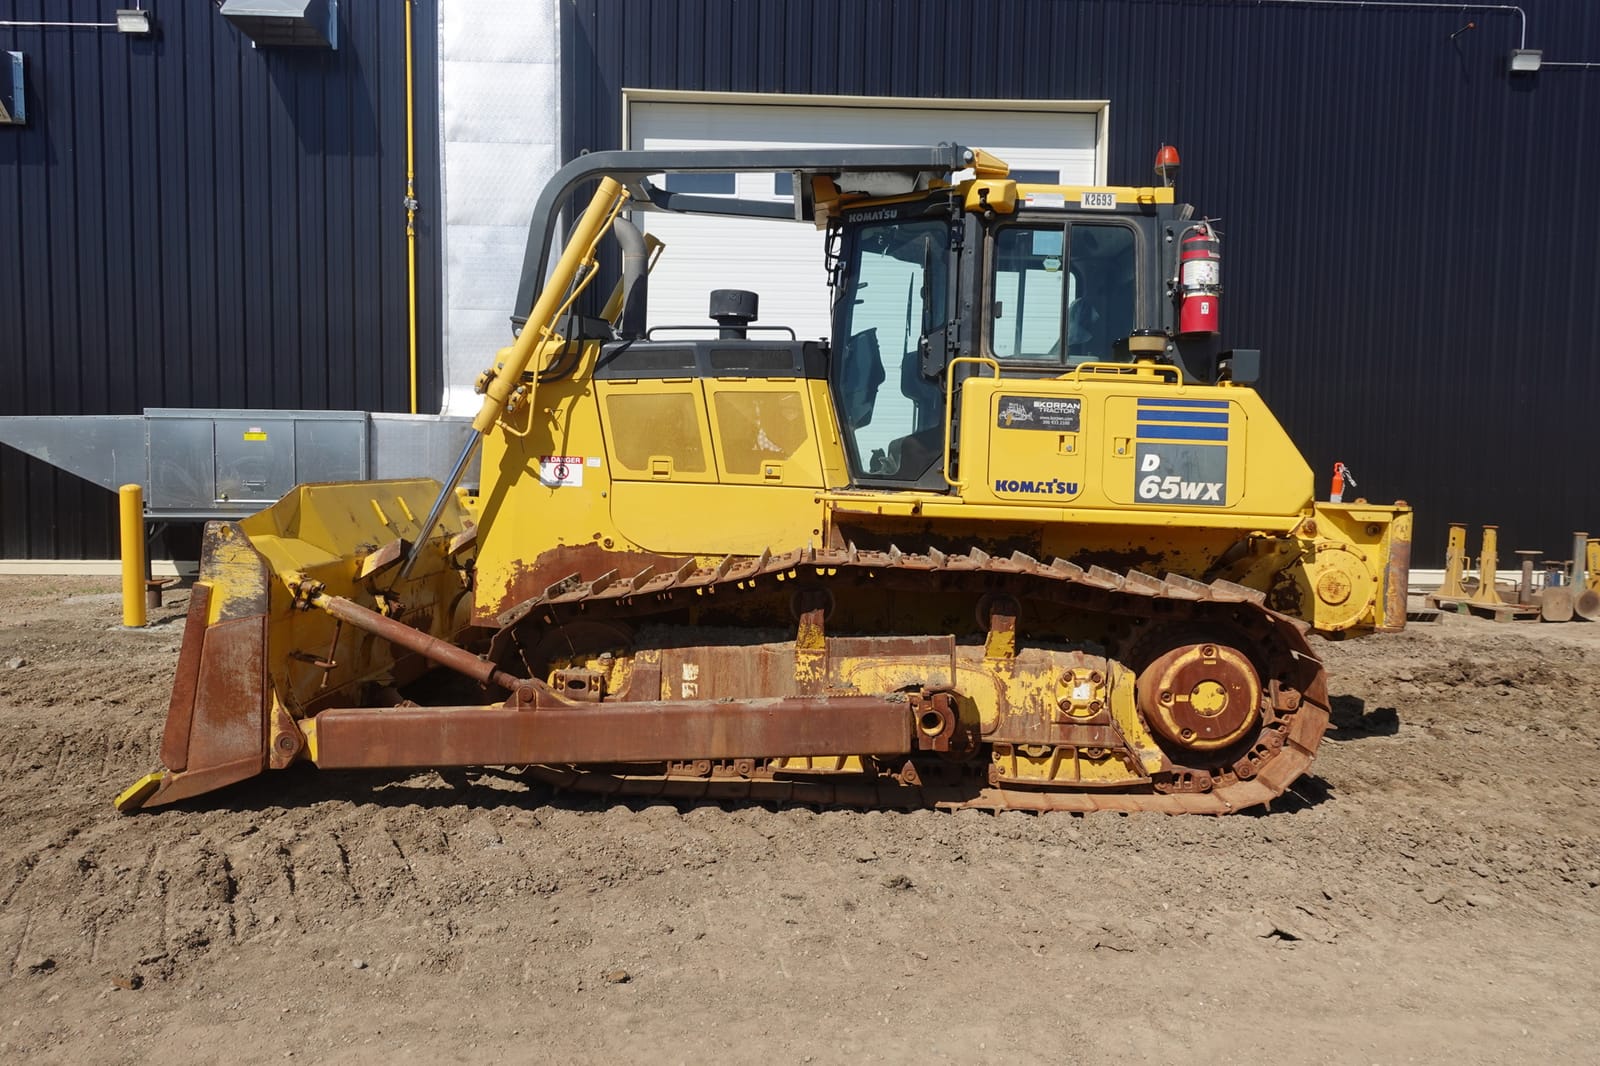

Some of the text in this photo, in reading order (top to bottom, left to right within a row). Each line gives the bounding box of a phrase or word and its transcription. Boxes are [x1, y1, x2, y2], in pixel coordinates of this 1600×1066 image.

[1084, 193, 1112, 206] K2693
[848, 208, 898, 222] KOMATSU
[550, 456, 581, 464] DANGER
[1140, 453, 1160, 472] D
[995, 478, 1078, 495] KOMATSU
[1138, 474, 1224, 501] 65WX
